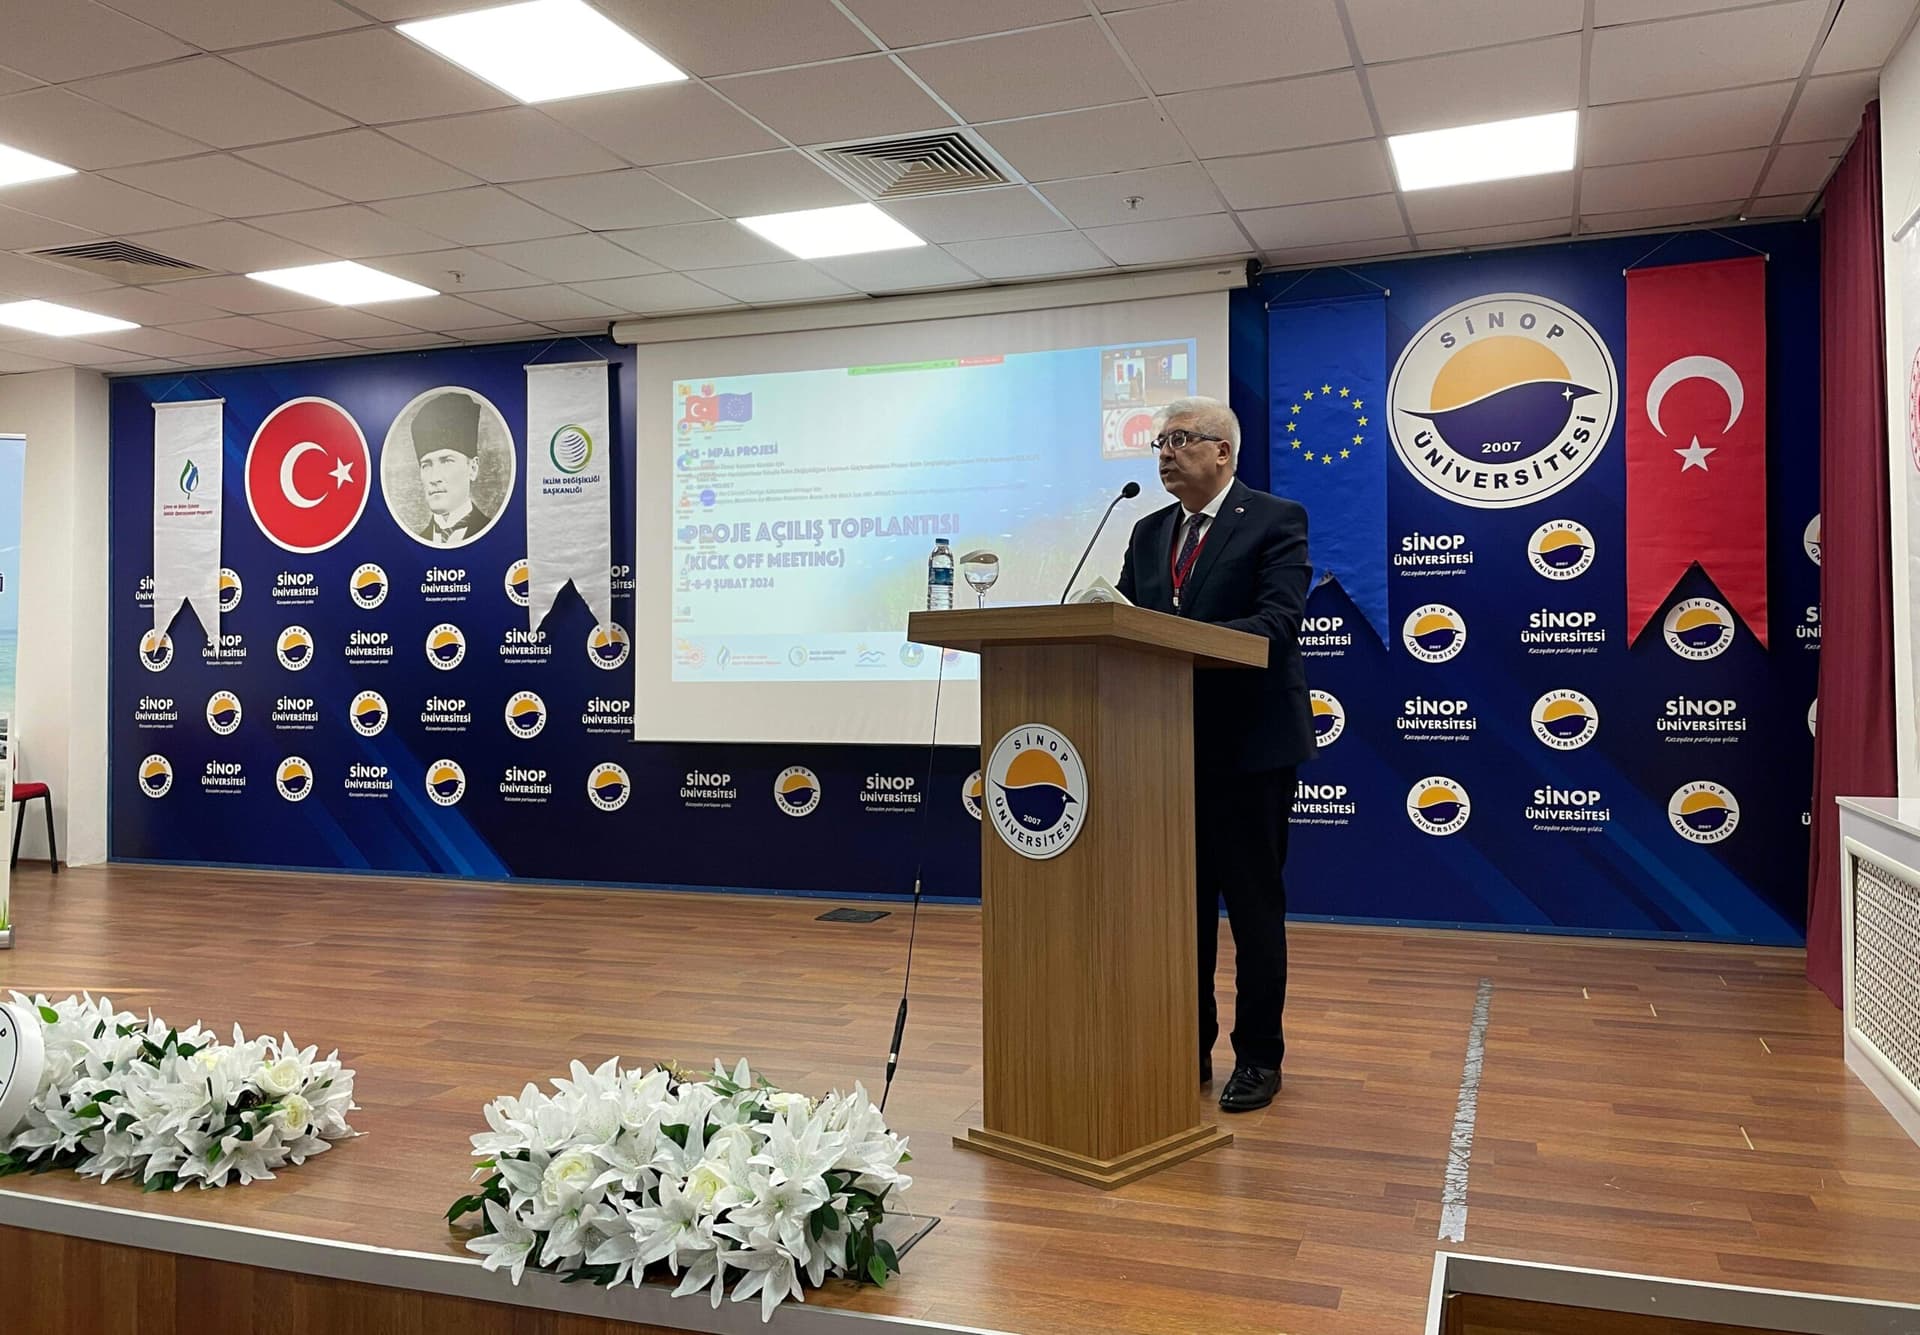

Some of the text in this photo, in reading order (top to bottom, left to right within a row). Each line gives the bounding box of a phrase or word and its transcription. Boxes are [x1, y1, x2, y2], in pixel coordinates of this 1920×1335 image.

[1440, 312, 1565, 348] SİNOP
[1413, 415, 1597, 489] ÜNİVERSİTESİ
[1482, 441, 1522, 454] 2007
[684, 514, 960, 548] PROJE AÇILIŞ TOPLANTISI
[1402, 532, 1465, 551] SİNOP
[734, 552, 764, 569] OFF
[278, 571, 314, 586] SİNOP
[426, 567, 466, 582] SİNOP
[140, 576, 154, 590] SİN
[750, 577, 775, 589] 2024
[1301, 617, 1344, 632] NOP
[1530, 608, 1597, 628] SİNOP
[350, 630, 389, 645] SİNOP
[1297, 633, 1352, 646] VERSİTESİ
[140, 696, 174, 710] SİNOP
[277, 696, 314, 711] SİNOP
[426, 696, 466, 711] SİNOP
[588, 697, 630, 712] SİNOP
[1311, 692, 1333, 704] NOP
[1405, 696, 1468, 716] SİNOP
[1666, 696, 1737, 716] SİNOP
[582, 713, 633, 724] ÜNİVERSİTES
[1014, 732, 1069, 762] SİNOP
[206, 760, 242, 775] SİNOP
[350, 763, 388, 778] SİNOP
[505, 766, 547, 782] SİNOP
[686, 770, 731, 786] SİNOP
[866, 773, 915, 790] SİNOP
[1294, 780, 1347, 800] İNOP
[1534, 785, 1601, 806] SİNOP
[1023, 814, 1042, 826] 2007
